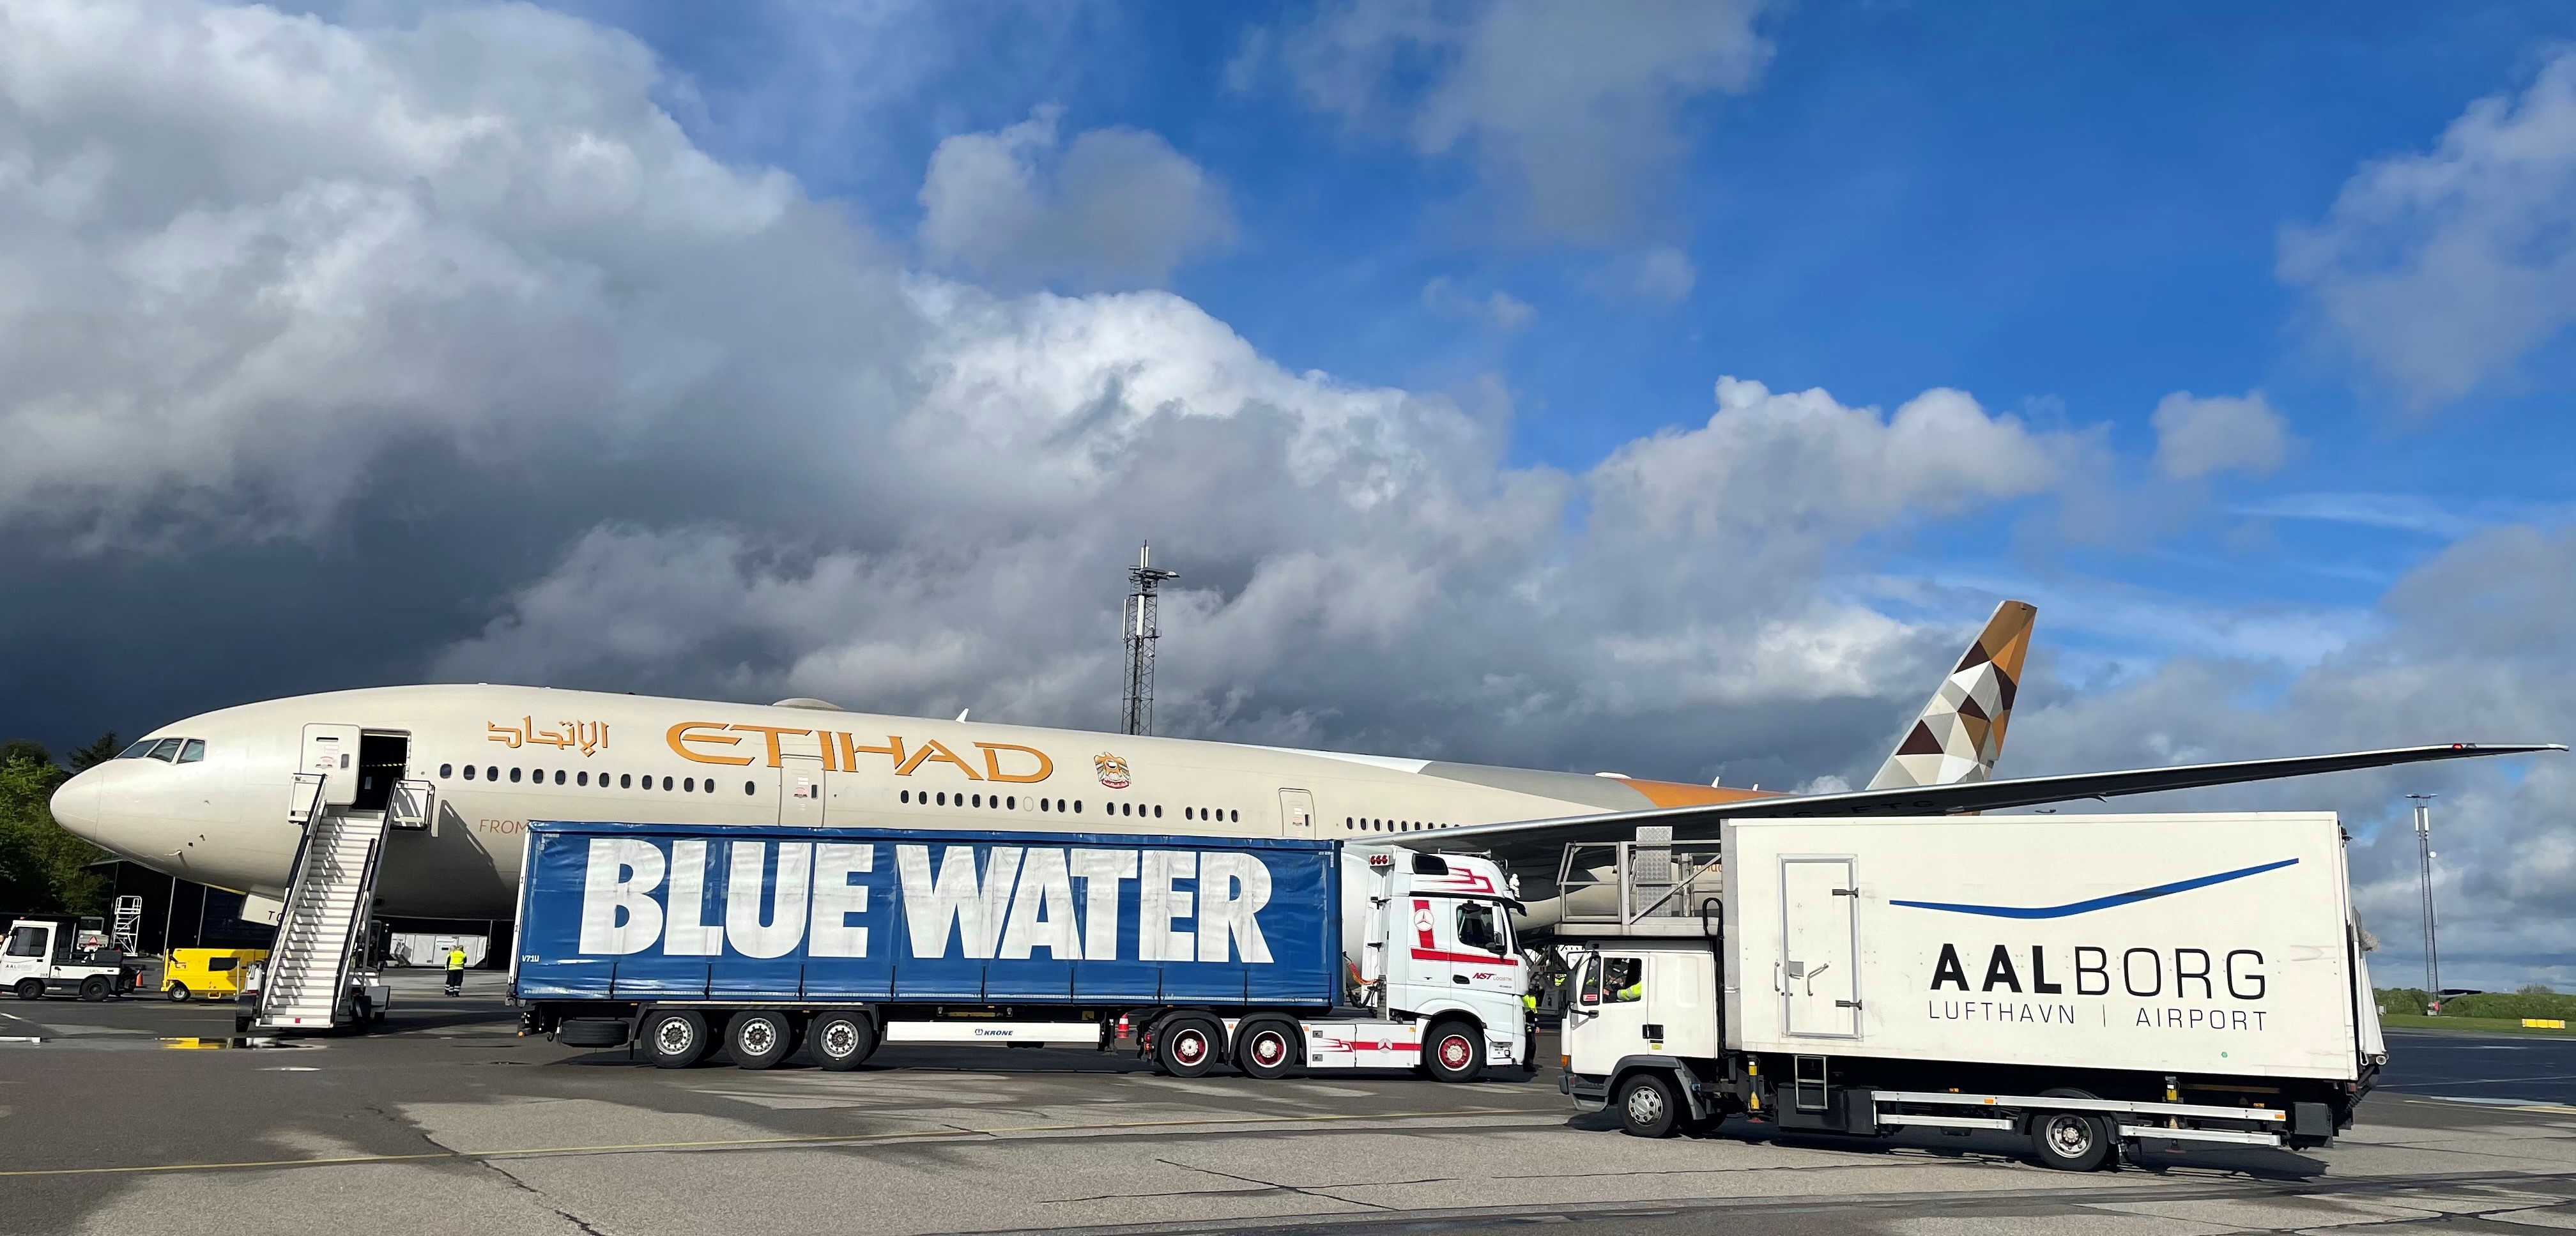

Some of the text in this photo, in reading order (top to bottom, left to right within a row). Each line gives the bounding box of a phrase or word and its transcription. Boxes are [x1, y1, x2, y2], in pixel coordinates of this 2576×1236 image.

[665, 721, 1054, 783] ETIHAD
[479, 819, 529, 834] FROM
[578, 838, 1275, 963] BLUE WATER
[1929, 943, 2266, 1000] AALBORG
[1929, 1000, 2267, 1031] LUFTHAVN AIRPORT
